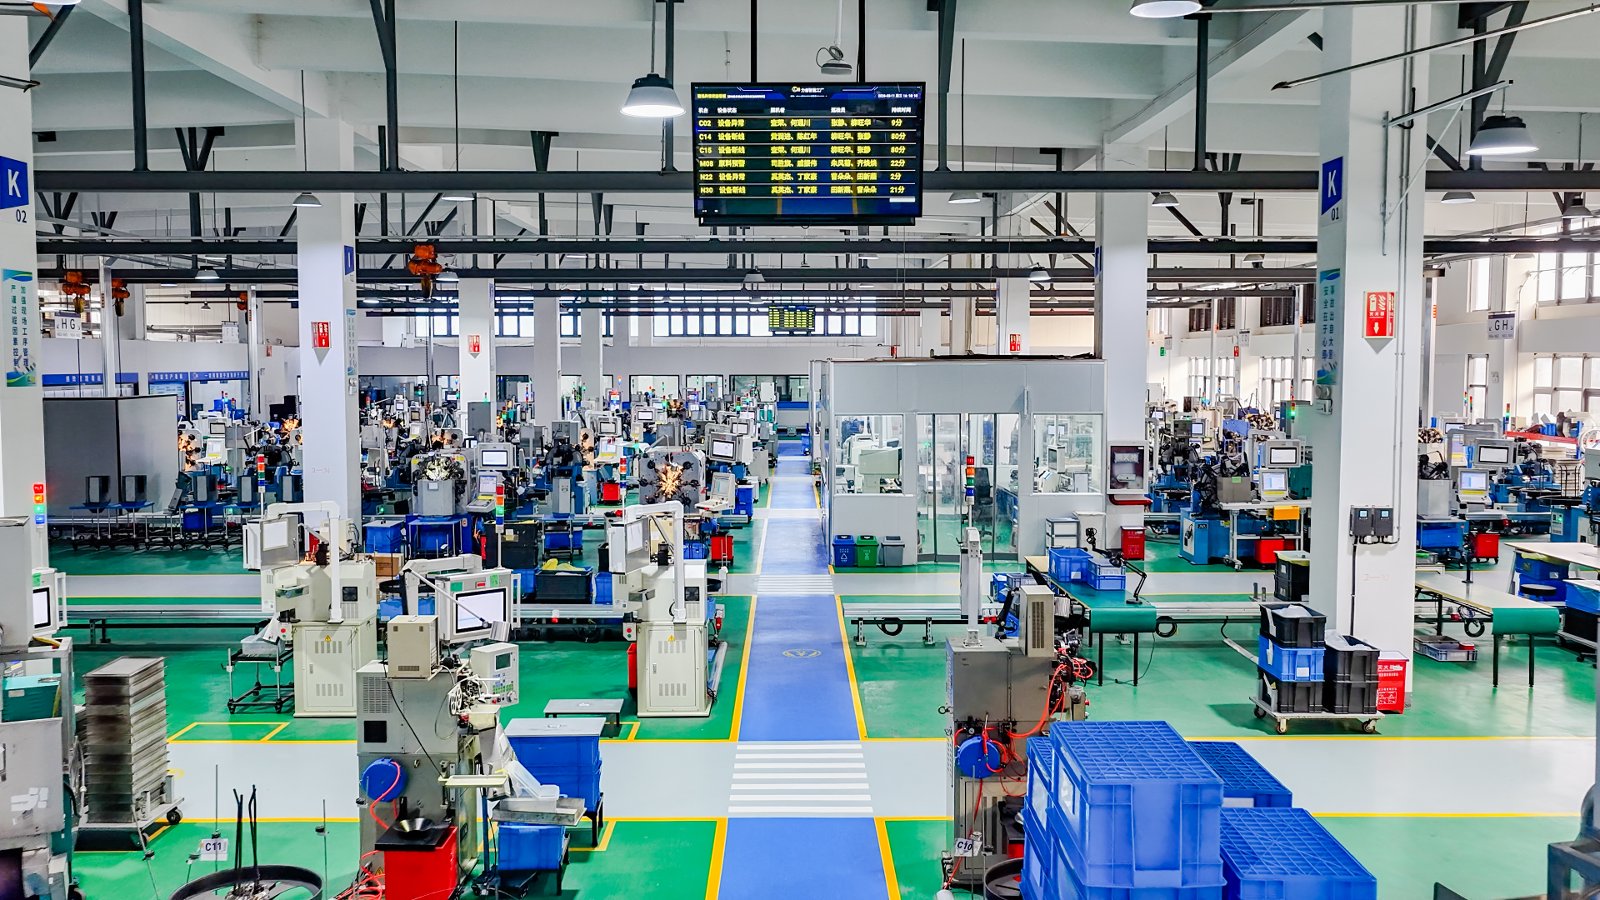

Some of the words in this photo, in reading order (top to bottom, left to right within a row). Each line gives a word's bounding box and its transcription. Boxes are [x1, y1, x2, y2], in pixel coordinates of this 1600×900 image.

[8, 168, 21, 198] K
[1328, 169, 1336, 198] K
[16, 209, 27, 223] 02
[1331, 207, 1339, 221] 01
[205, 842, 221, 851] C11
[957, 841, 972, 850] C10
